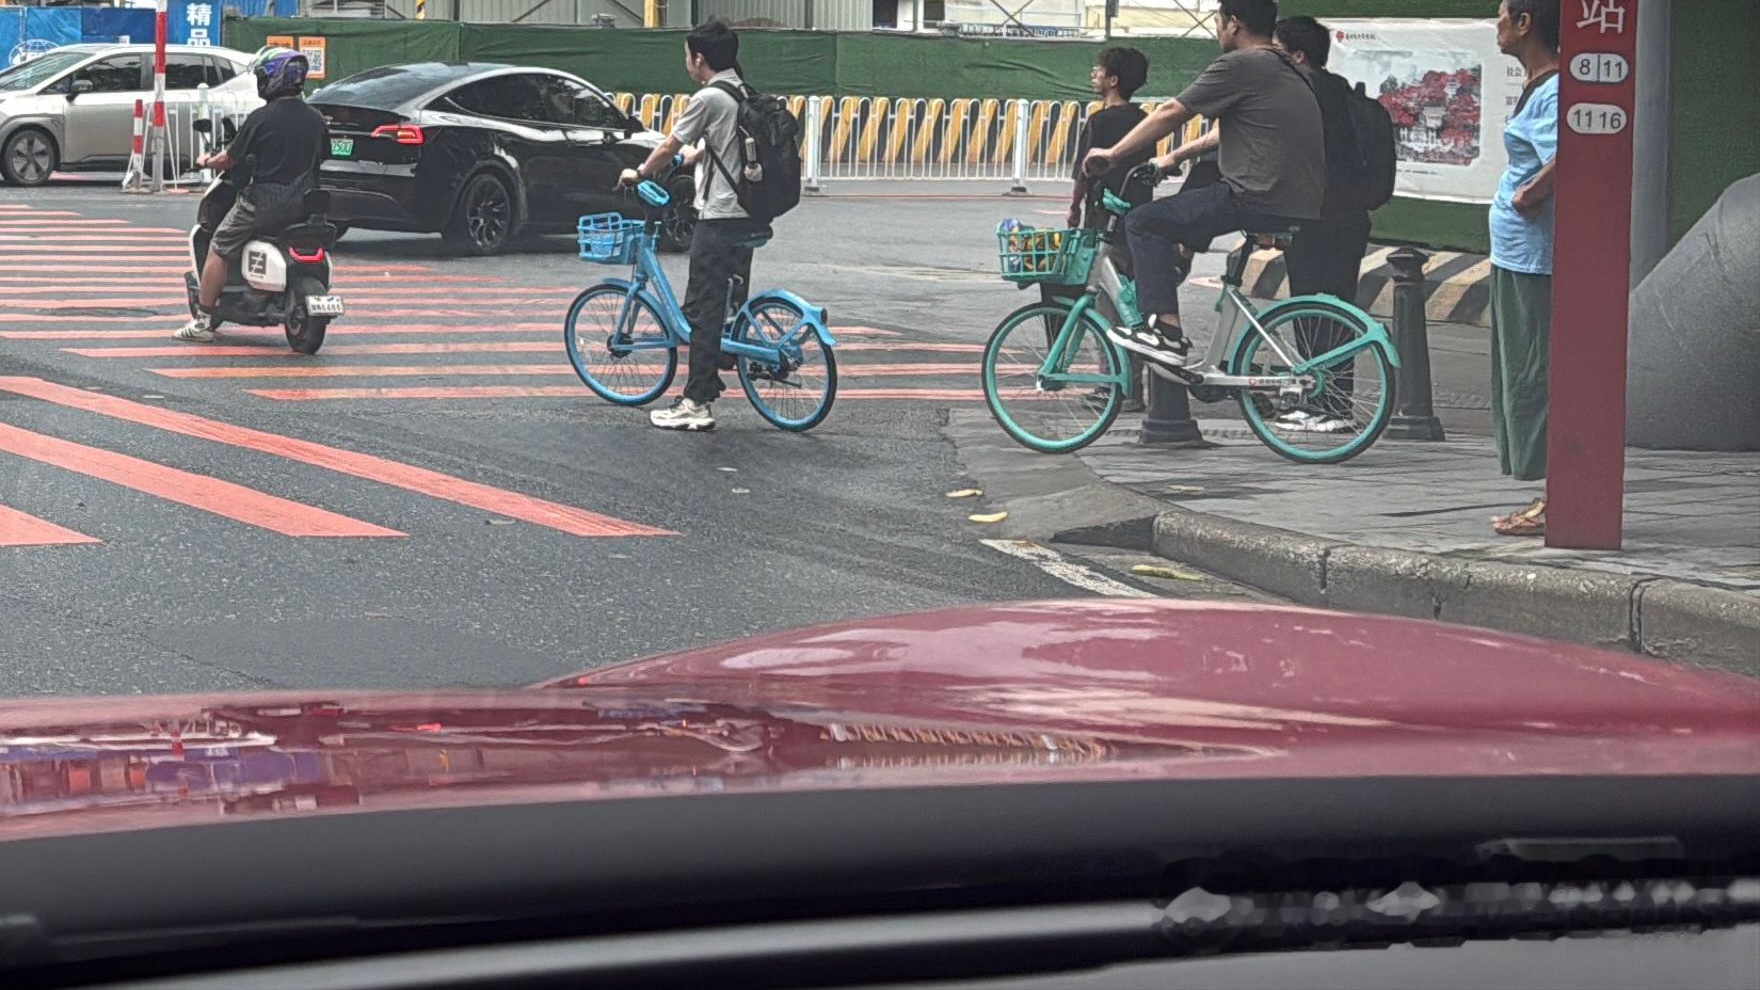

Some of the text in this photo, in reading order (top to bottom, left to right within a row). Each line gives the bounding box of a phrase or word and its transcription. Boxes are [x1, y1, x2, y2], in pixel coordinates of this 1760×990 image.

[186, 2, 212, 46] 精品
[1579, 59, 1623, 78] 8 11
